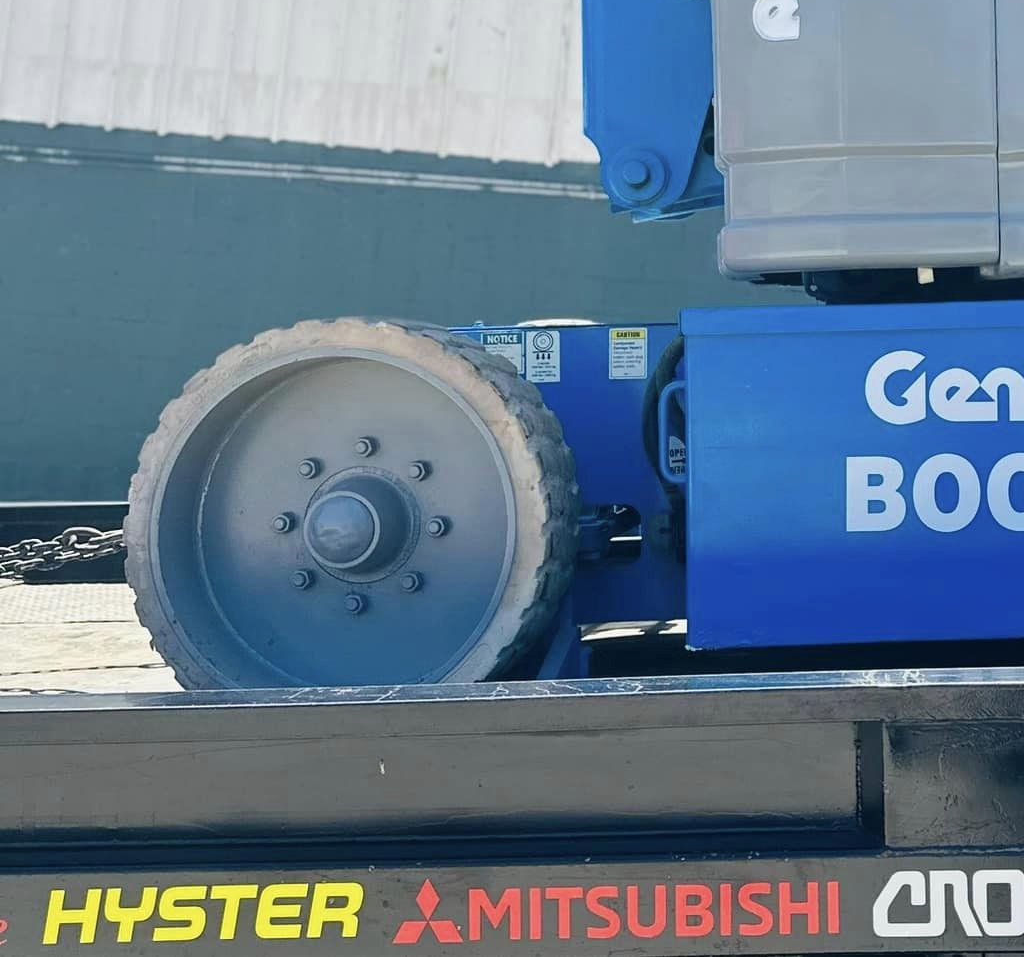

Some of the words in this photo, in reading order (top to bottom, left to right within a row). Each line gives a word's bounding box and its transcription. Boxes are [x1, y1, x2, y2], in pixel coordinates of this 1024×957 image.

[486, 334, 519, 345] NOTICE
[43, 883, 363, 945] HYSTER
[468, 881, 840, 940] MITSUBISHI
